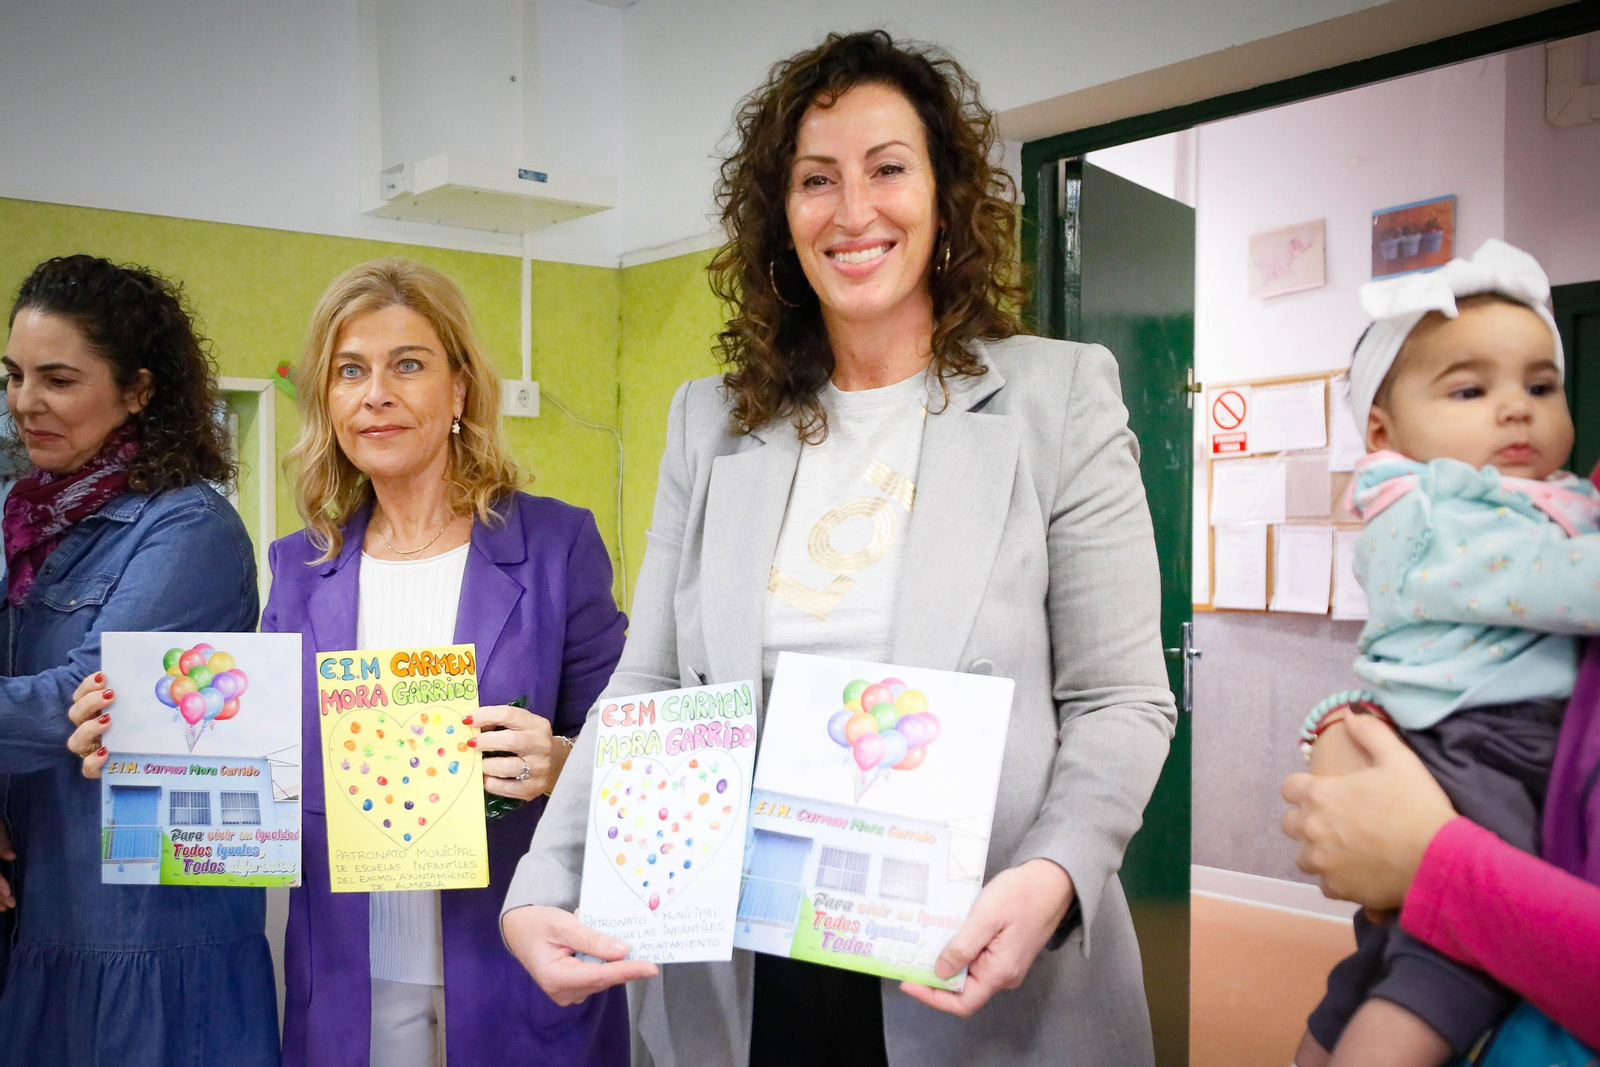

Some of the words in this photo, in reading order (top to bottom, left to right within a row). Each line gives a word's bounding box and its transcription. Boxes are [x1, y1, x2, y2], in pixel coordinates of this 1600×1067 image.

[390, 650, 476, 677] CARMEN
[321, 684, 388, 716] MORA
[661, 684, 752, 722] CARMEN
[596, 730, 662, 767] MORA
[108, 761, 140, 775] E.I.M.
[144, 763, 187, 775] Carmen
[189, 763, 218, 776] Mora
[755, 801, 792, 819] E.I.M.
[796, 808, 849, 829] Carmen
[850, 818, 885, 836] Mora
[170, 828, 204, 841] Para
[207, 829, 235, 841] vivir
[173, 843, 213, 859] Todos
[336, 849, 407, 860] PATRONATO
[183, 858, 226, 874] Todos
[336, 864, 348, 873] DE
[355, 863, 402, 873] ESCUELAS
[337, 876, 356, 884] DEL
[371, 883, 385, 891] DE
[813, 892, 855, 913] Para
[584, 913, 647, 928] PATRONATO
[813, 910, 861, 933] Todos
[821, 930, 873, 957] Todos
